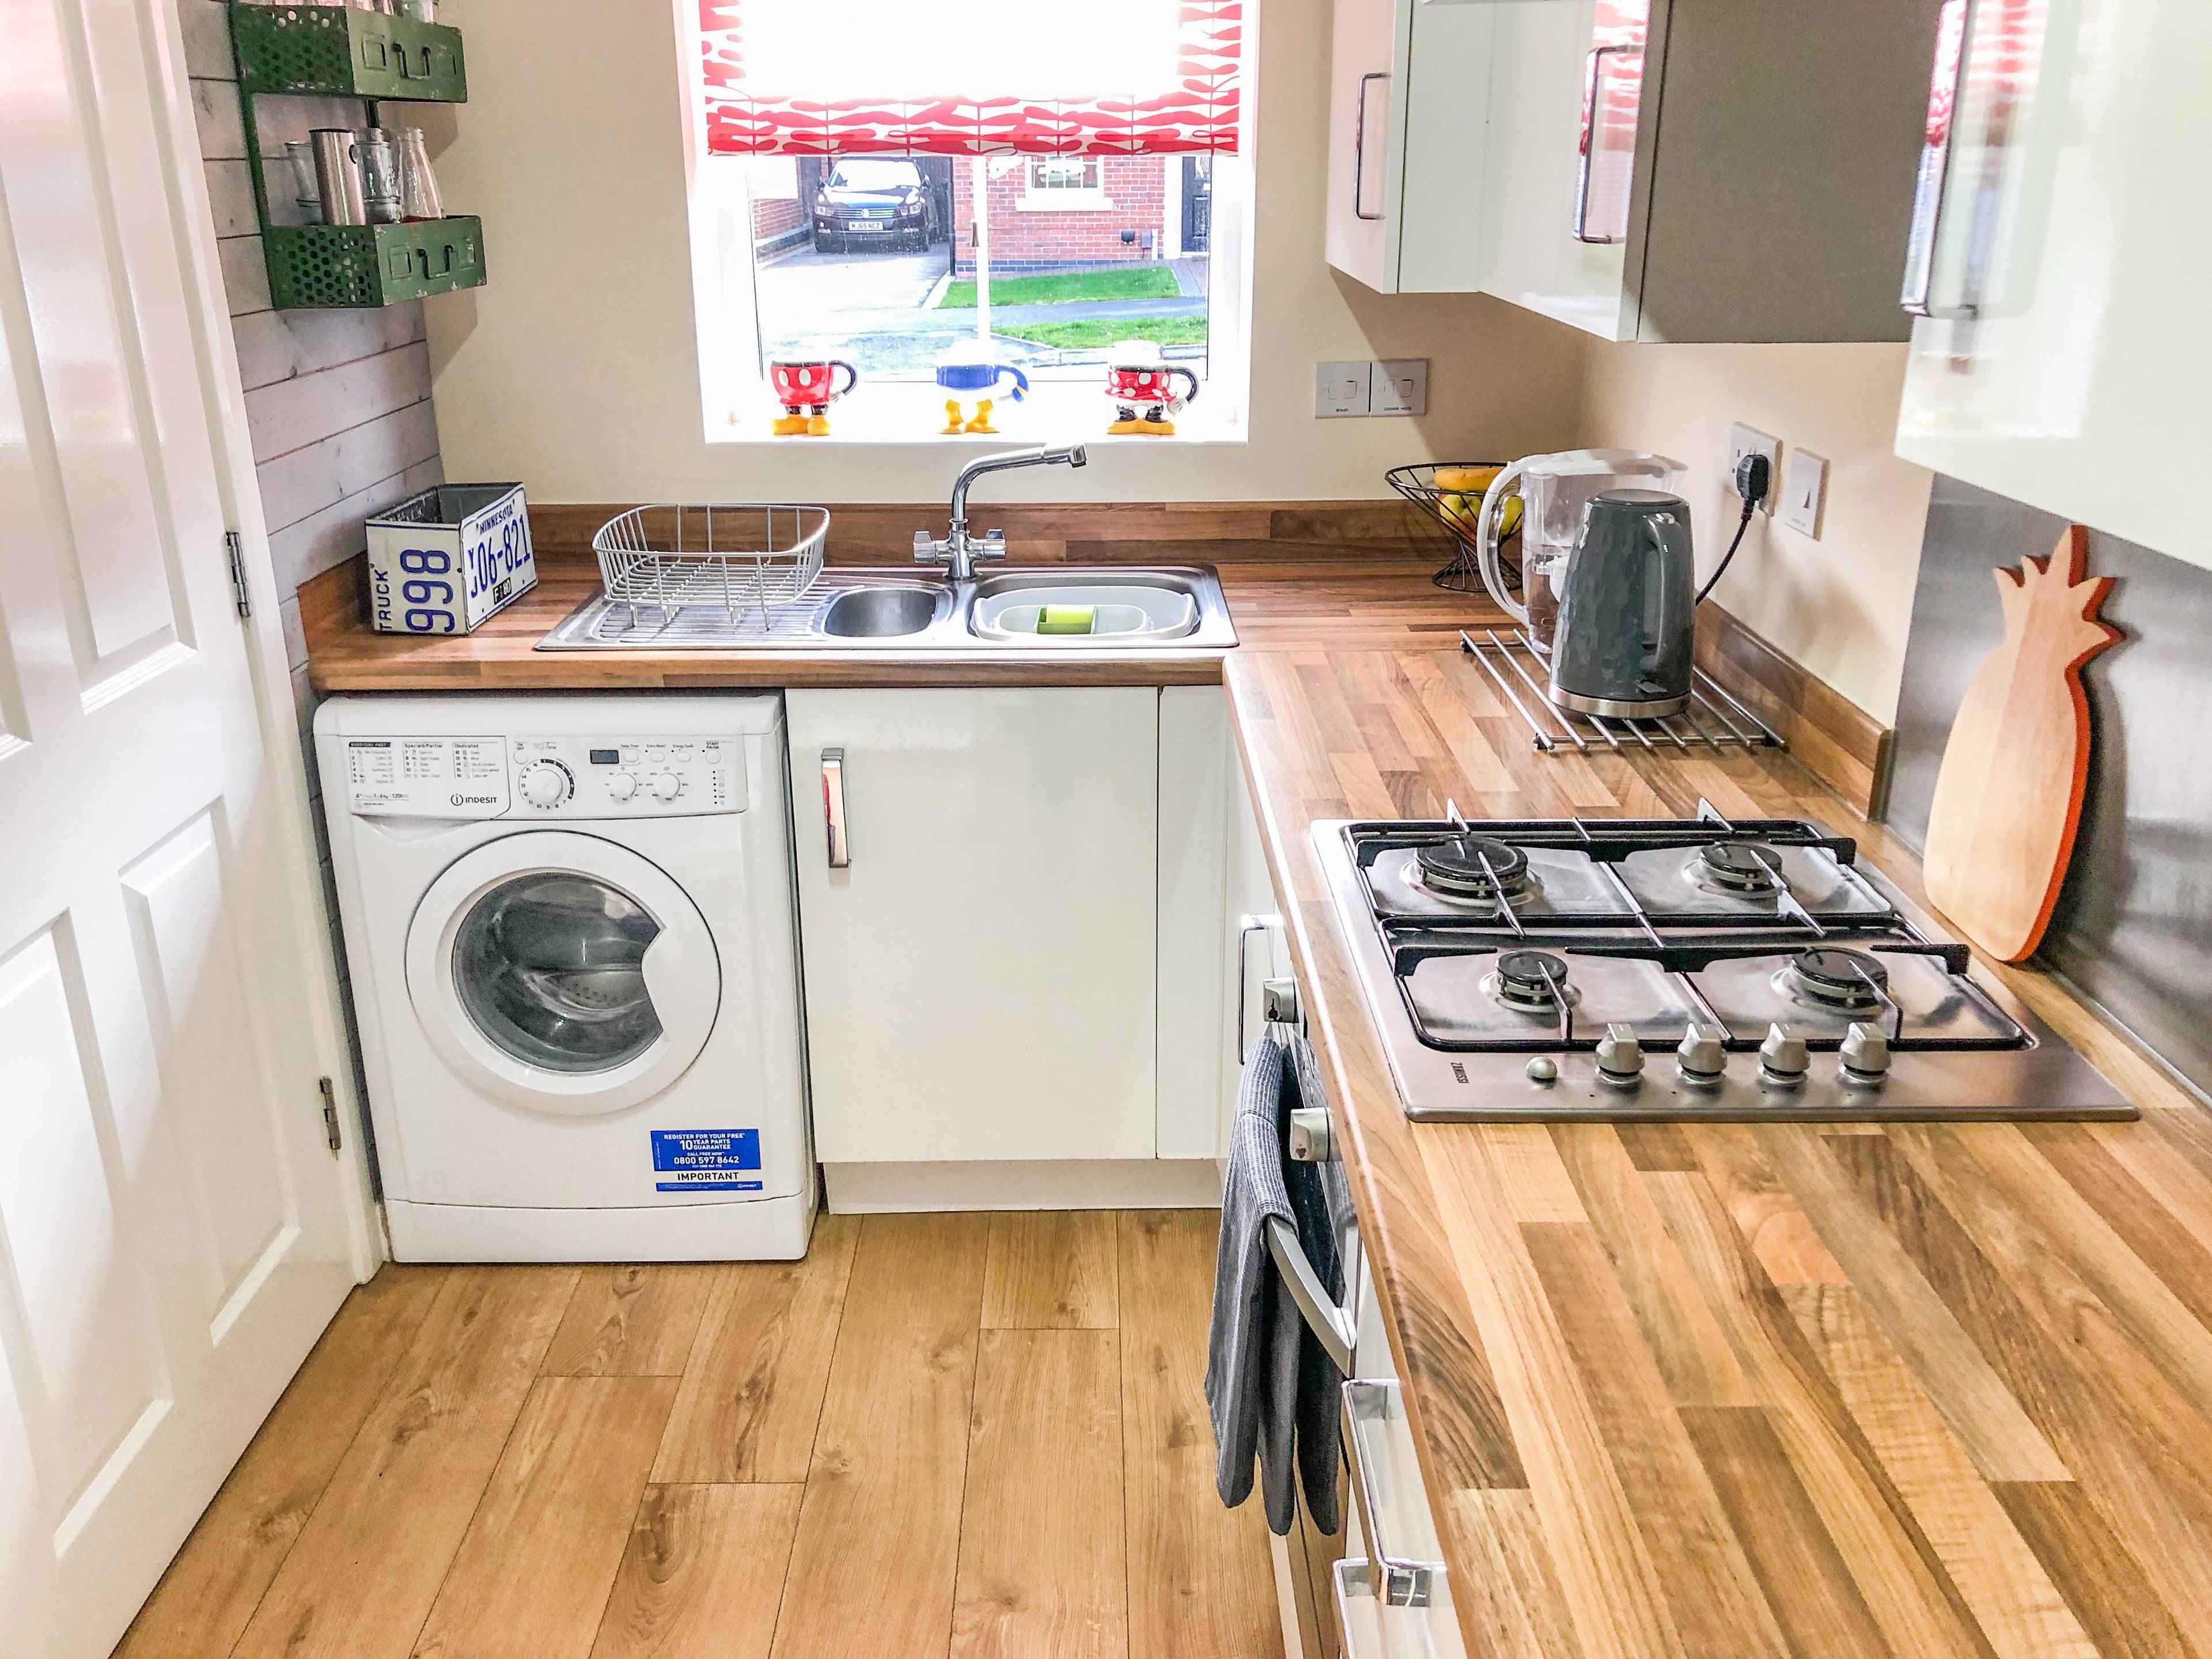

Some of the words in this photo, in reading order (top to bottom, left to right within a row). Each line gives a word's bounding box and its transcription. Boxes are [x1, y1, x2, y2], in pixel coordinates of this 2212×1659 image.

[480, 504, 513, 535] MINNESOTA
[374, 569, 392, 631] TRUCK
[400, 549, 455, 632] 998
[680, 1140, 693, 1150] 10
[717, 1156, 740, 1164] 8642
[677, 1172, 739, 1181] IMPORTANT
